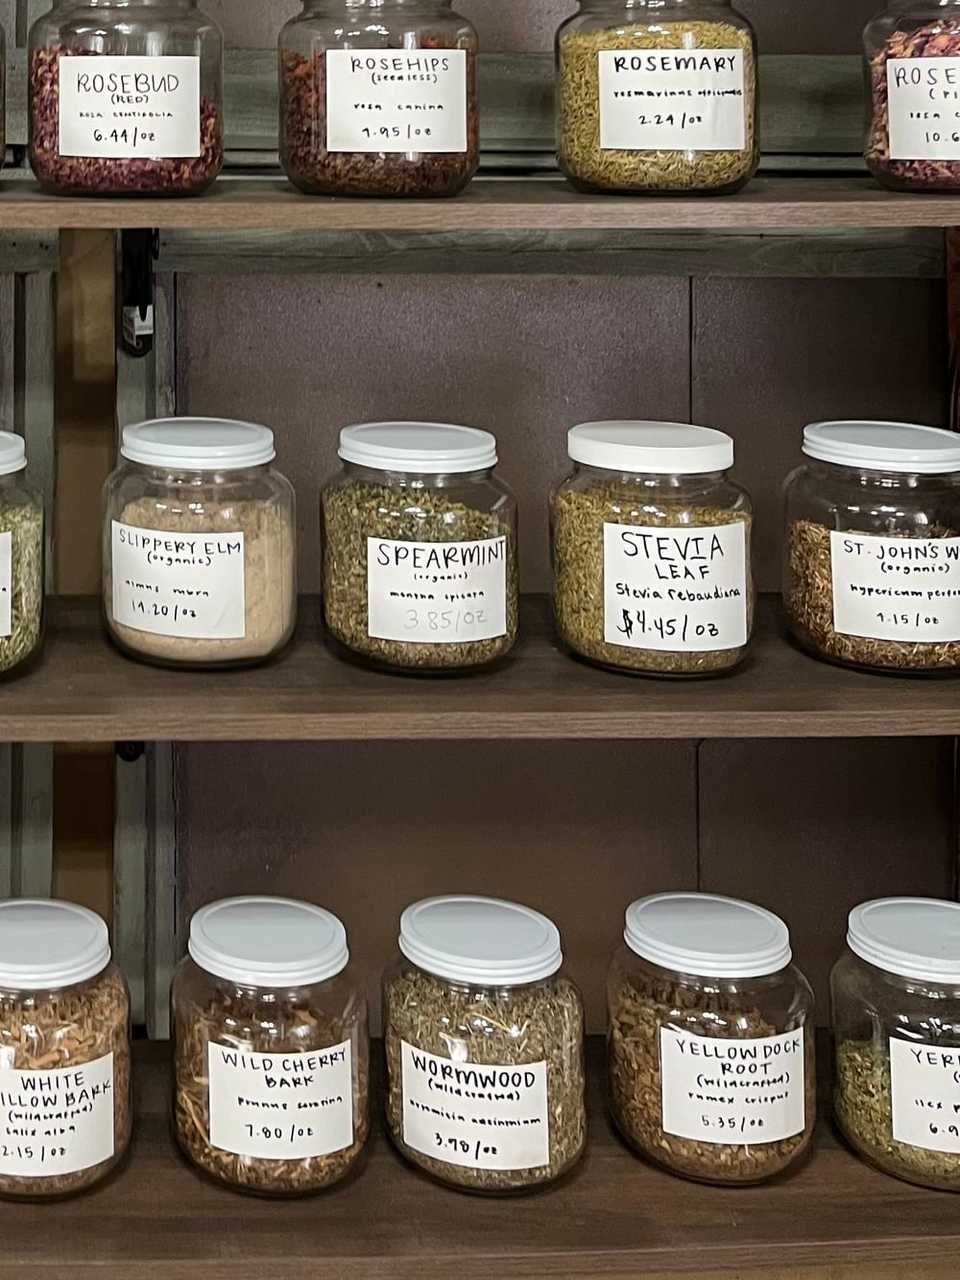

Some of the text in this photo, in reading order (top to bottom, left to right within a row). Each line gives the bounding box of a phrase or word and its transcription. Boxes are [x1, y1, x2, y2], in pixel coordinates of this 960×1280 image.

[350, 56, 449, 72] ROSEHIPS
[614, 55, 736, 72] ROSEMARY
[77, 72, 179, 93] ROSEBUD
[110, 94, 150, 105] (RED)
[119, 528, 242, 556] SLIPPERY ELM
[620, 530, 724, 561] STEVIA
[876, 541, 939, 560] JOHN'S
[146, 551, 213, 567] (organic)
[377, 539, 505, 569] SPEARMINT
[654, 563, 710, 581] LEAF
[880, 561, 951, 575] (organic)
[615, 582, 662, 599] Stevia
[676, 1038, 800, 1061] YELLOW DOCK
[221, 1048, 346, 1073] WILD CHERRY
[411, 1050, 536, 1089] WORMWOOD
[720, 1062, 773, 1076] ROOT
[19, 1071, 85, 1091] WHITE
[264, 1074, 315, 1089] BARK
[64, 1079, 112, 1108] BARK
